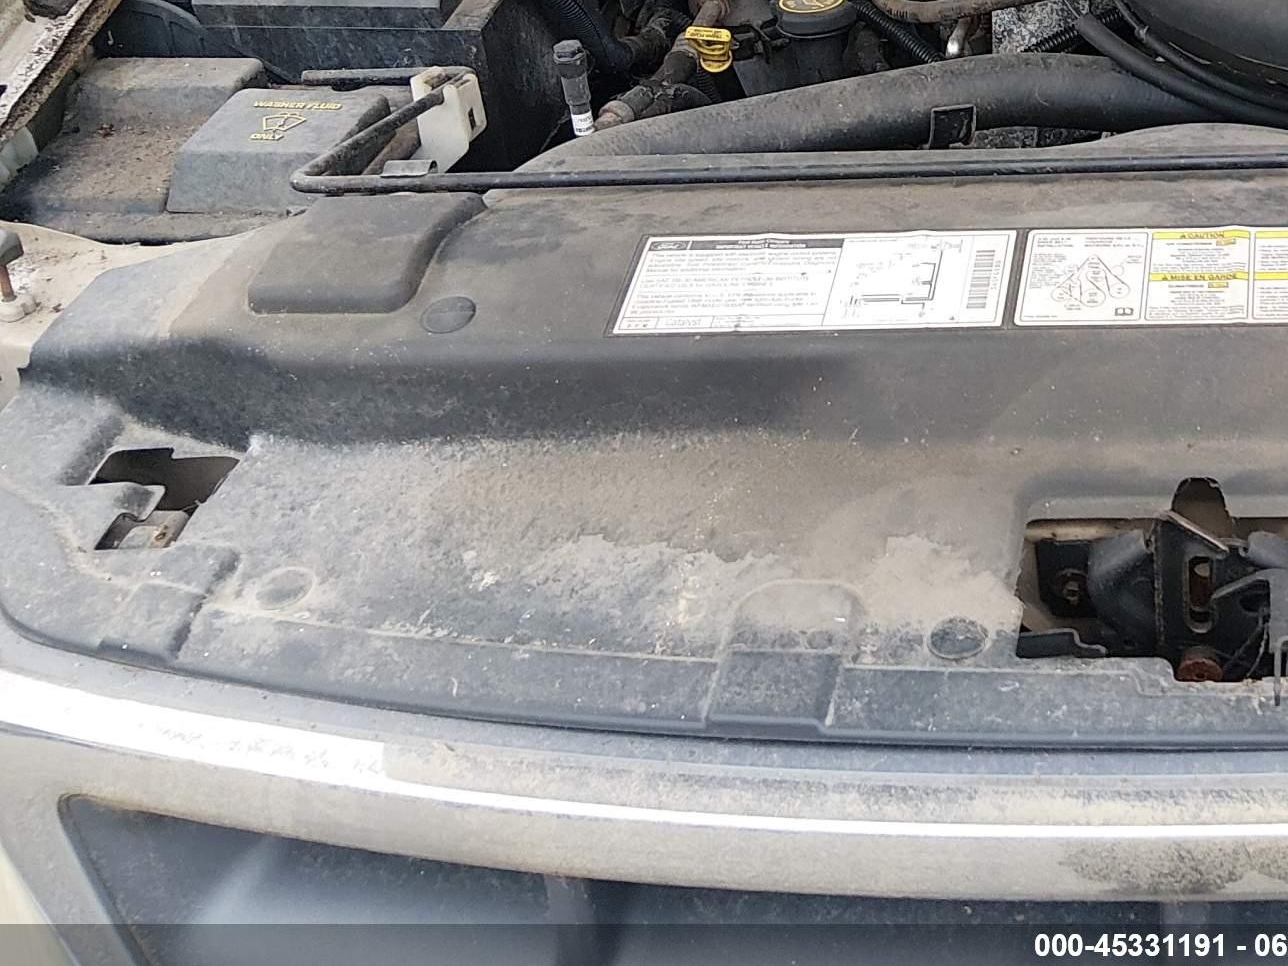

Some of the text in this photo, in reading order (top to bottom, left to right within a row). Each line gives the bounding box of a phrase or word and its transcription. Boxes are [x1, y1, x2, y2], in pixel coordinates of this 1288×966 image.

[254, 100, 343, 110] WASHER FLUID
[250, 133, 284, 141] ONLY
